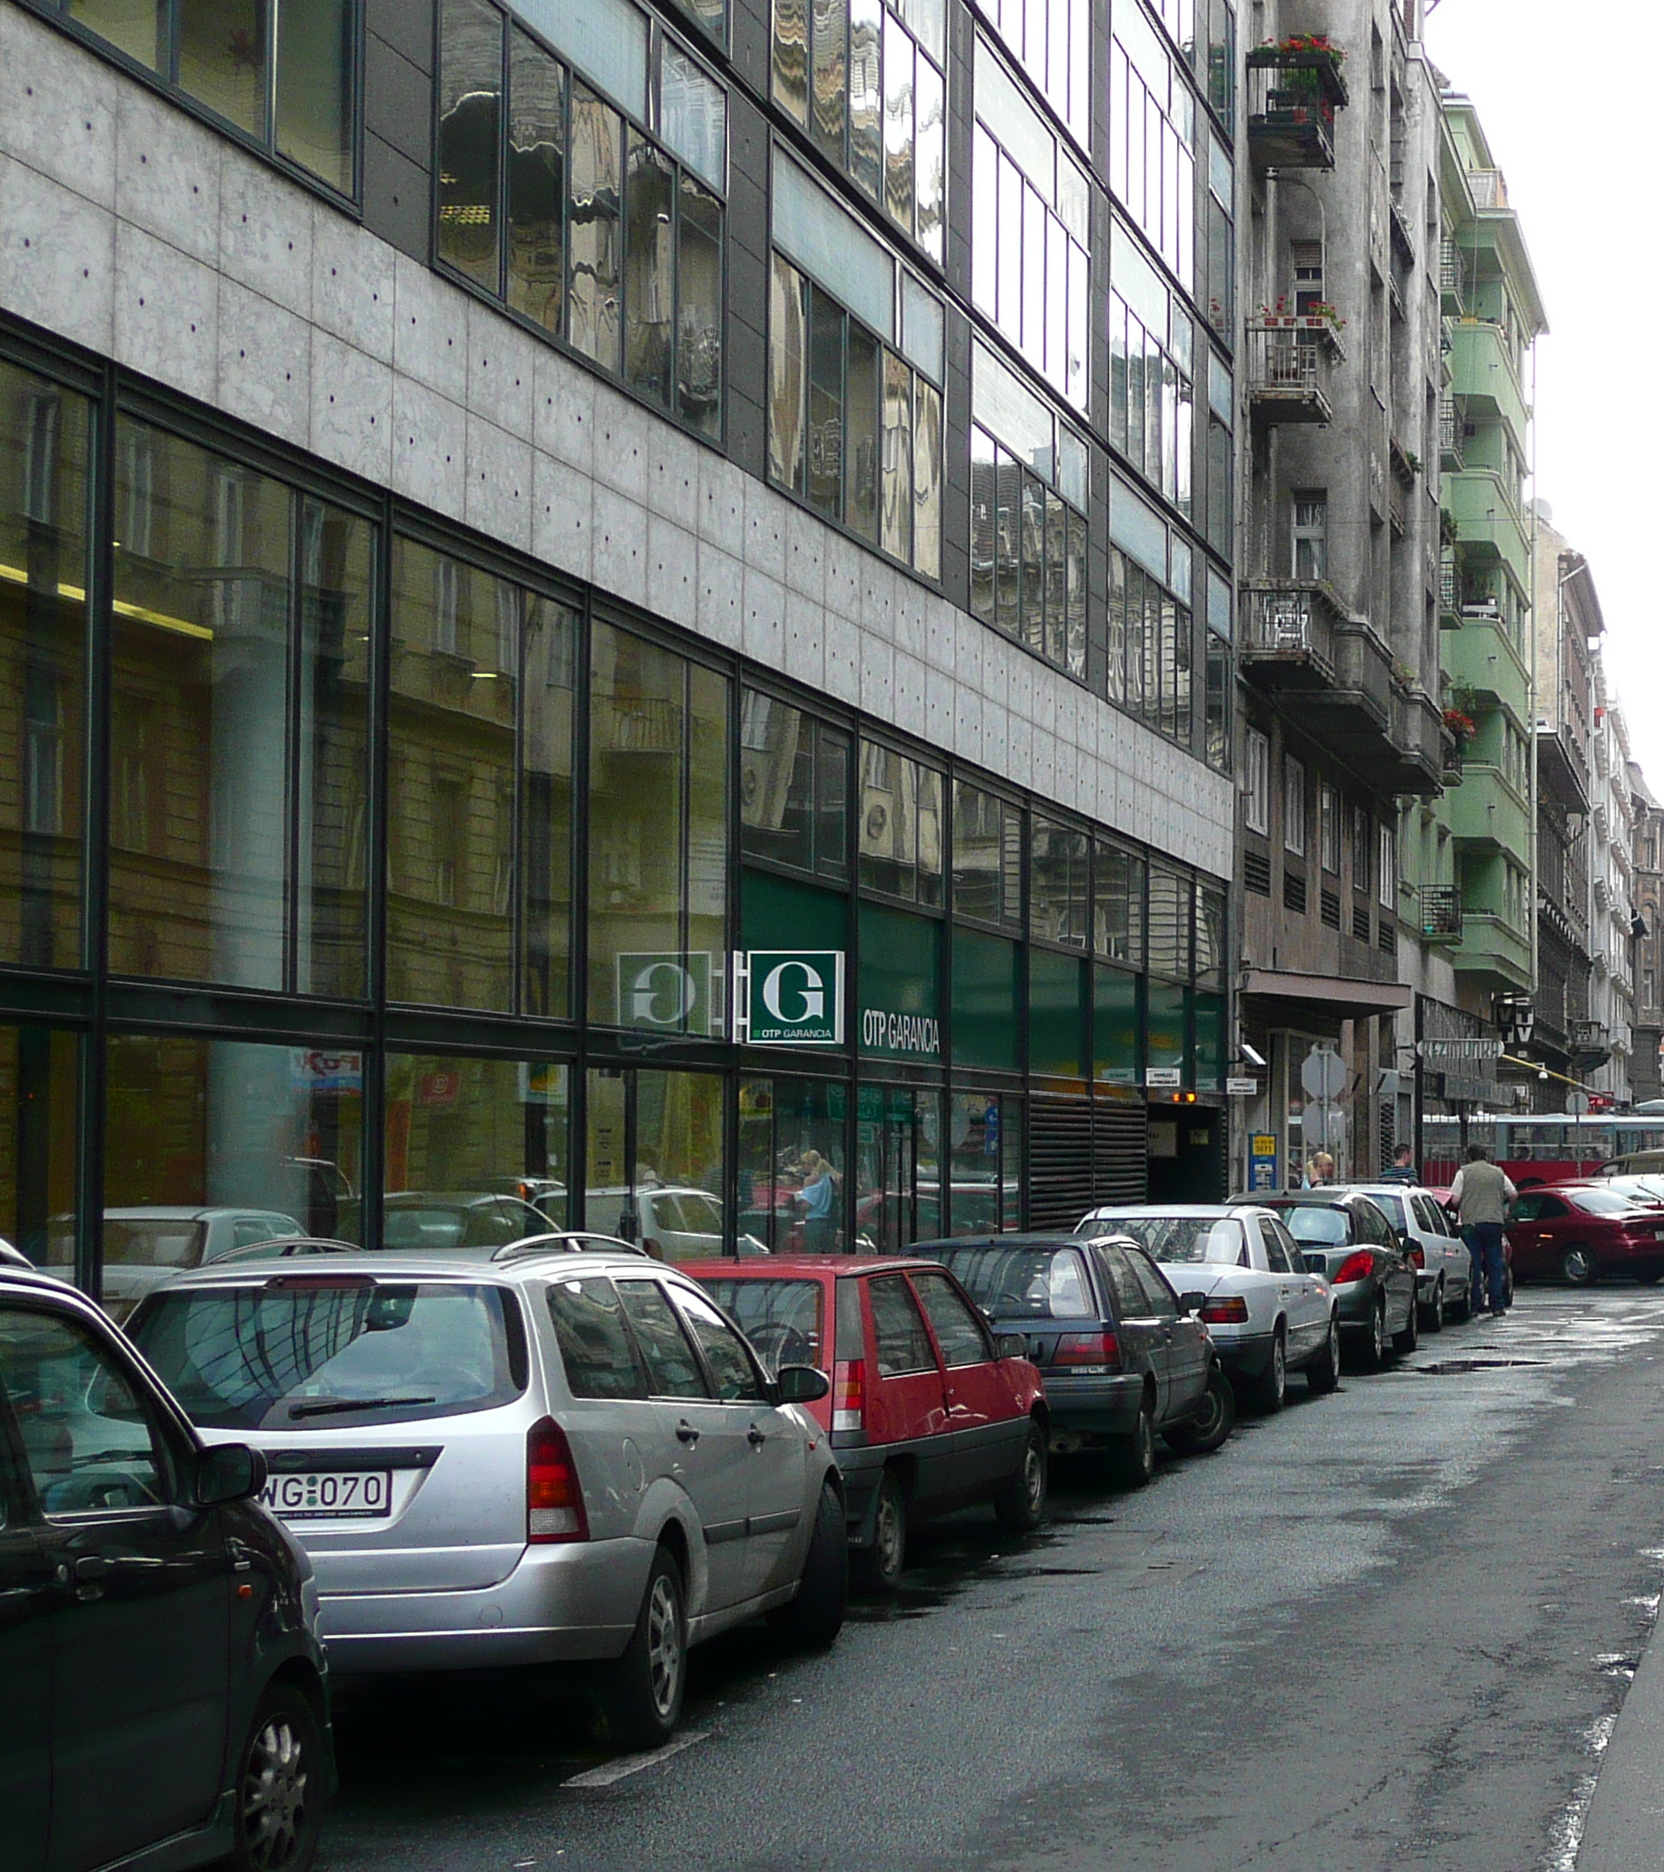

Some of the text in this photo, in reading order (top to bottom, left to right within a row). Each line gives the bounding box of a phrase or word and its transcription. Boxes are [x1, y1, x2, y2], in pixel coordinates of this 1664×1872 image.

[763, 961, 823, 1023] G
[761, 1029, 832, 1038] OTP GARANCIA
[863, 1008, 940, 1053] OTP GARANCIA
